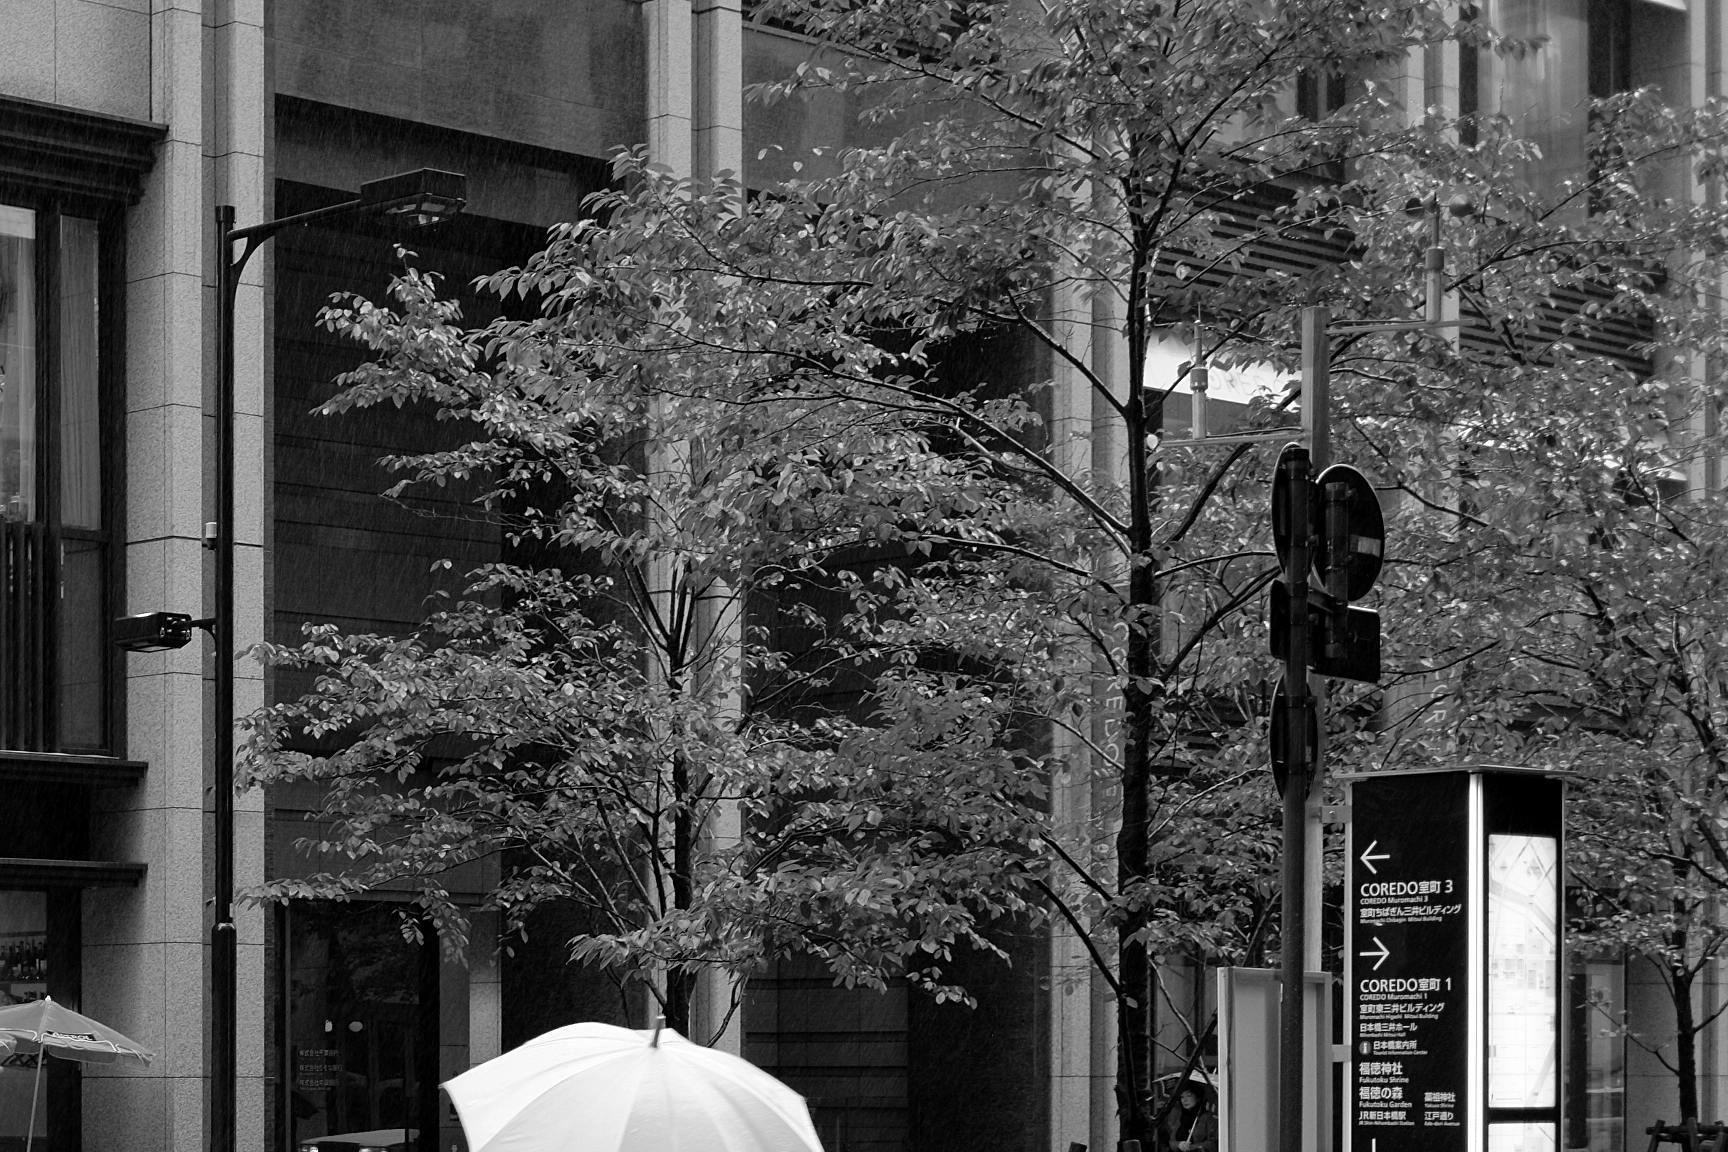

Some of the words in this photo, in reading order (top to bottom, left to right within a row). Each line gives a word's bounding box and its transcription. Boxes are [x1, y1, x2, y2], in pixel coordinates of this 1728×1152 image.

[1444, 880, 1453, 893] 3
[1360, 904, 1462, 918] 室町ちばぎん三井ビルディング
[1446, 978, 1451, 991] 1
[1360, 1002, 1445, 1014] 室町東三井ビルディング
[1360, 1023, 1417, 1032] 日本橋三井ホール
[1374, 1040, 1417, 1049] 日本橋案内所
[1359, 1062, 1403, 1075] 福徳神社
[1359, 1086, 1403, 1100] 福徳の森
[1359, 1111, 1406, 1120] JR新日本橋駅
[1425, 1111, 1454, 1120] 江戸通り
